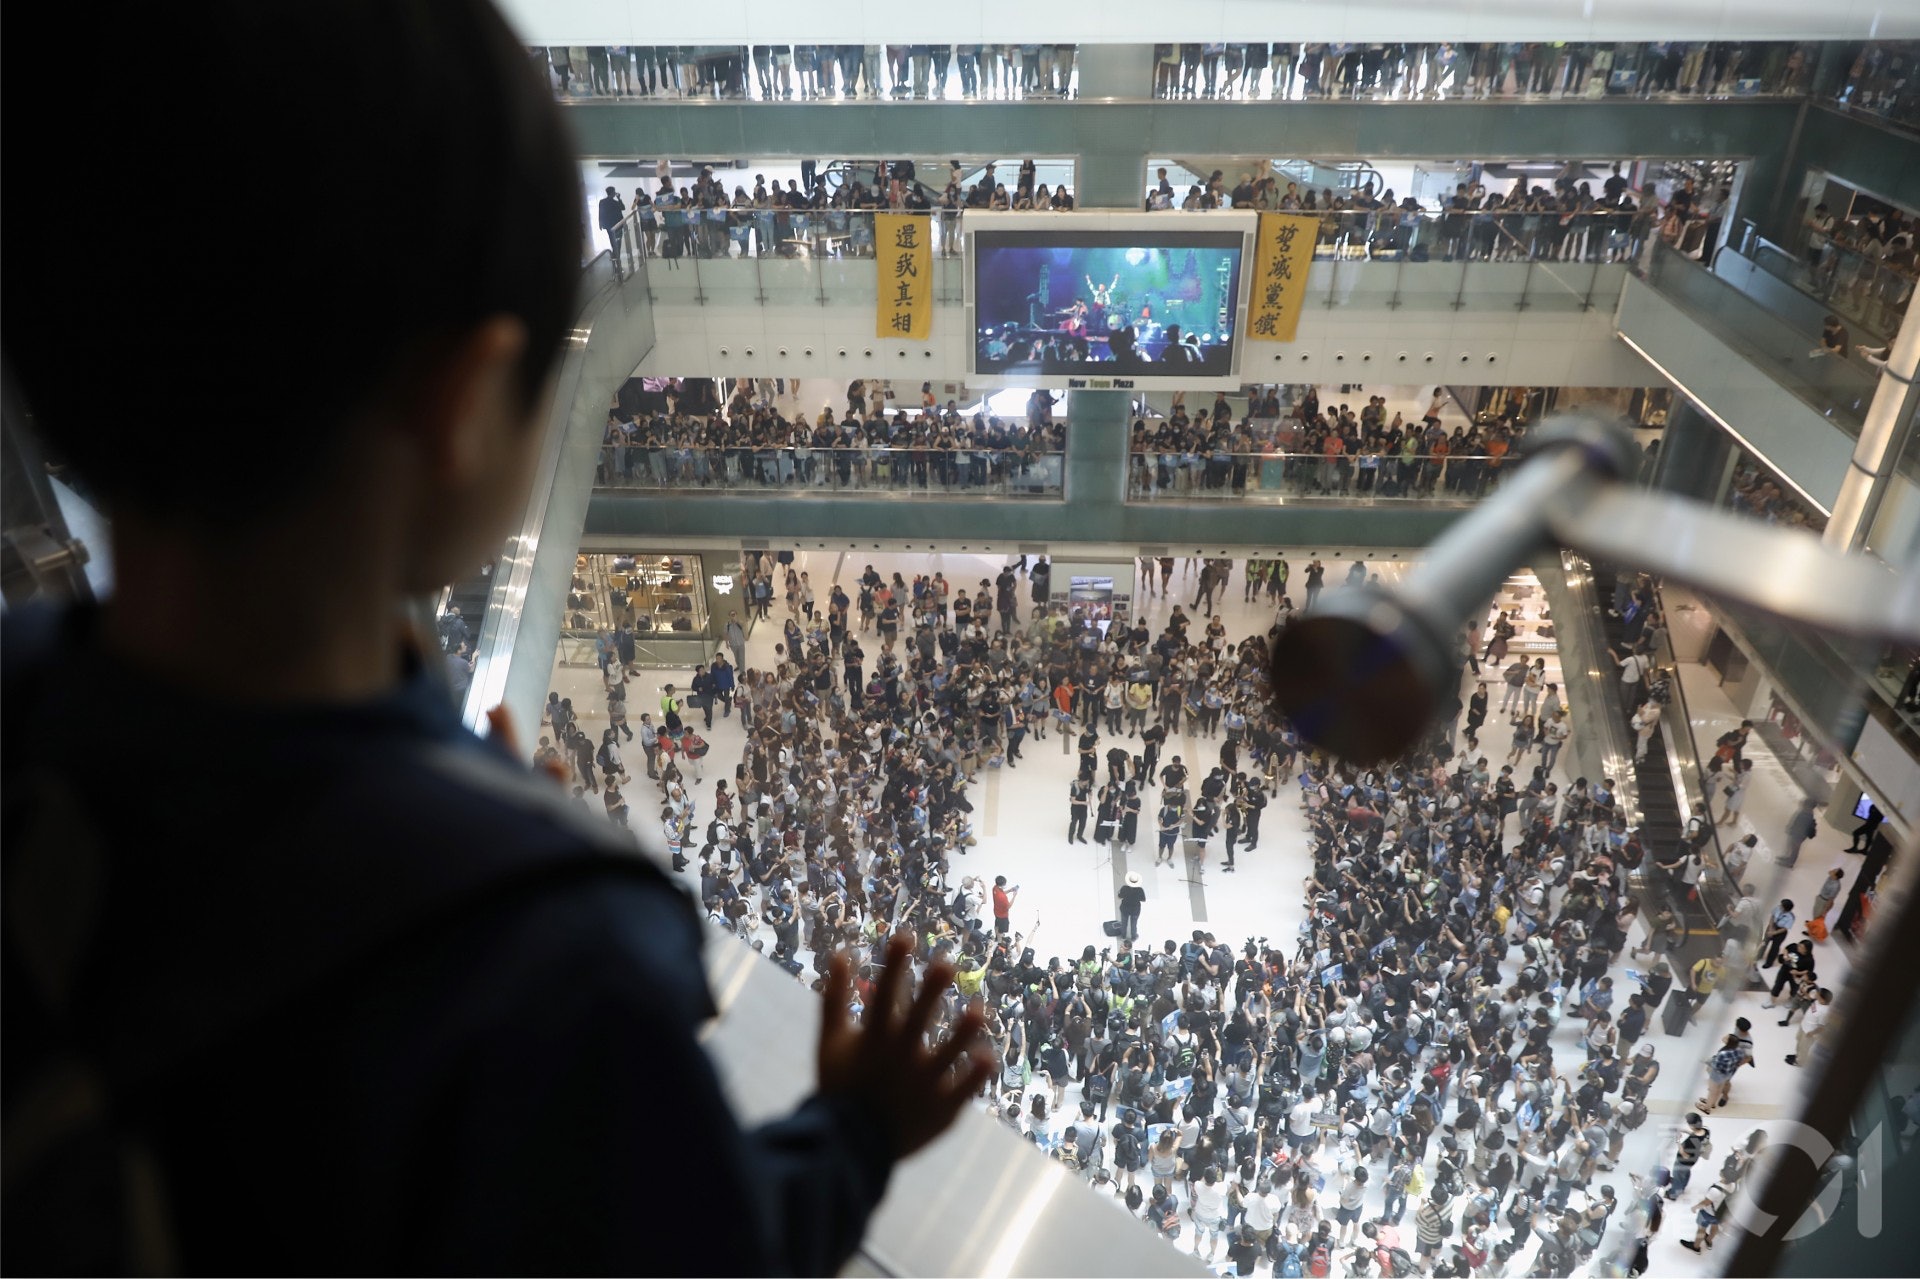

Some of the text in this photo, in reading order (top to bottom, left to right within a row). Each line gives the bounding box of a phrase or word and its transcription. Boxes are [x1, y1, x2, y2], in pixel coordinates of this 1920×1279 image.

[891, 224, 919, 333] 還我真相
[1069, 378, 1086, 388] New
[1113, 379, 1134, 388] Plaza
